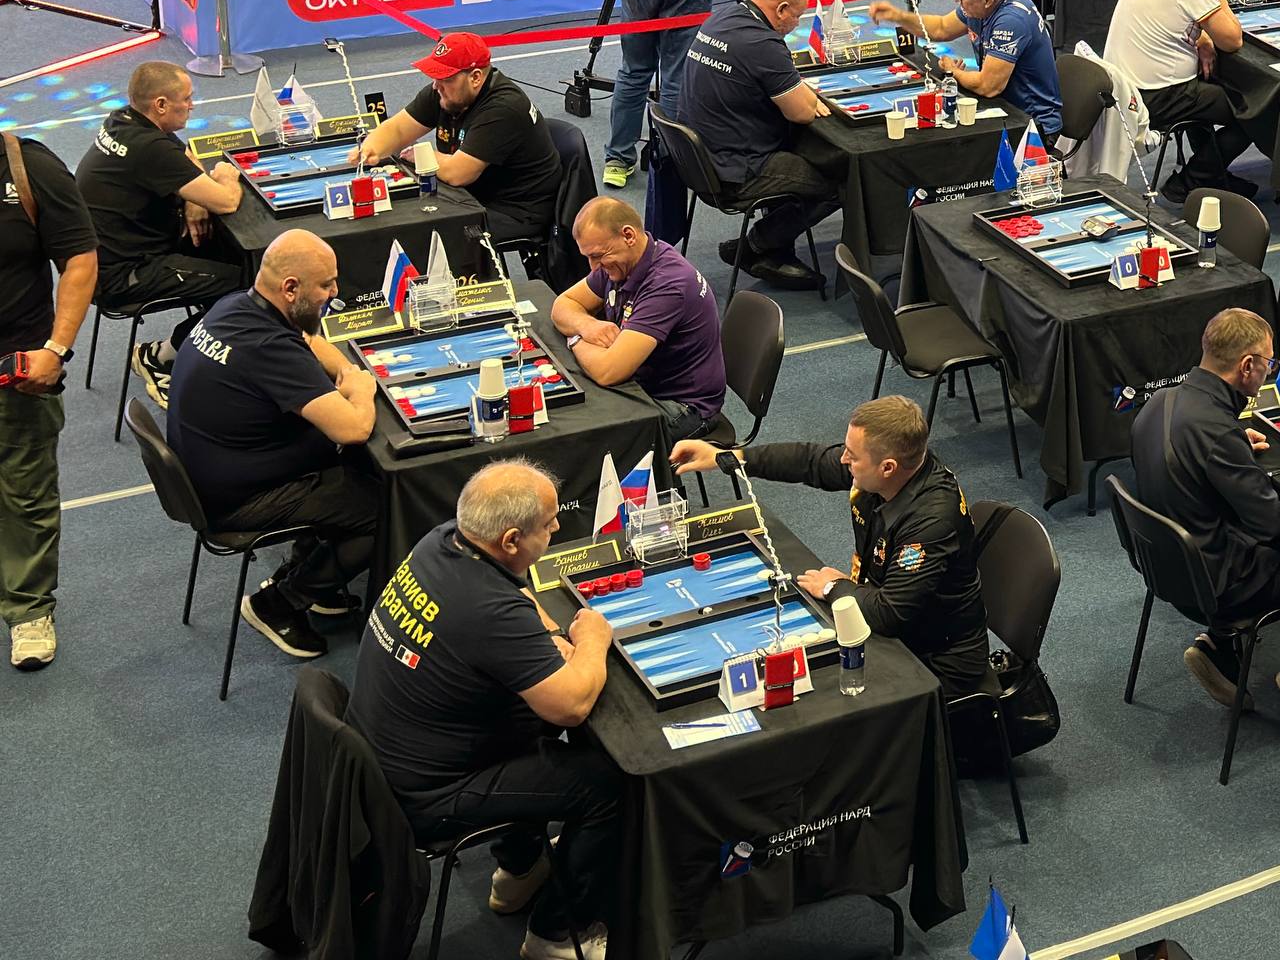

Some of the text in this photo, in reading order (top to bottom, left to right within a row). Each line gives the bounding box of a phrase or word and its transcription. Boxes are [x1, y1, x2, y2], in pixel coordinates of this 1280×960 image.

[710, 38, 728, 53] НАРД
[898, 33, 912, 47] 21
[701, 55, 732, 74] ОБЛАСТИ
[368, 101, 386, 115] 25
[903, 106, 910, 117] 0
[979, 178, 994, 188] НАР
[335, 193, 344, 204] 2
[1125, 262, 1132, 274] 0
[397, 551, 440, 622] аниев
[739, 672, 748, 689] 1
[768, 805, 872, 845] ФЕДЕРАЦИЯ НАРД
[767, 835, 815, 859] РОССИИ
